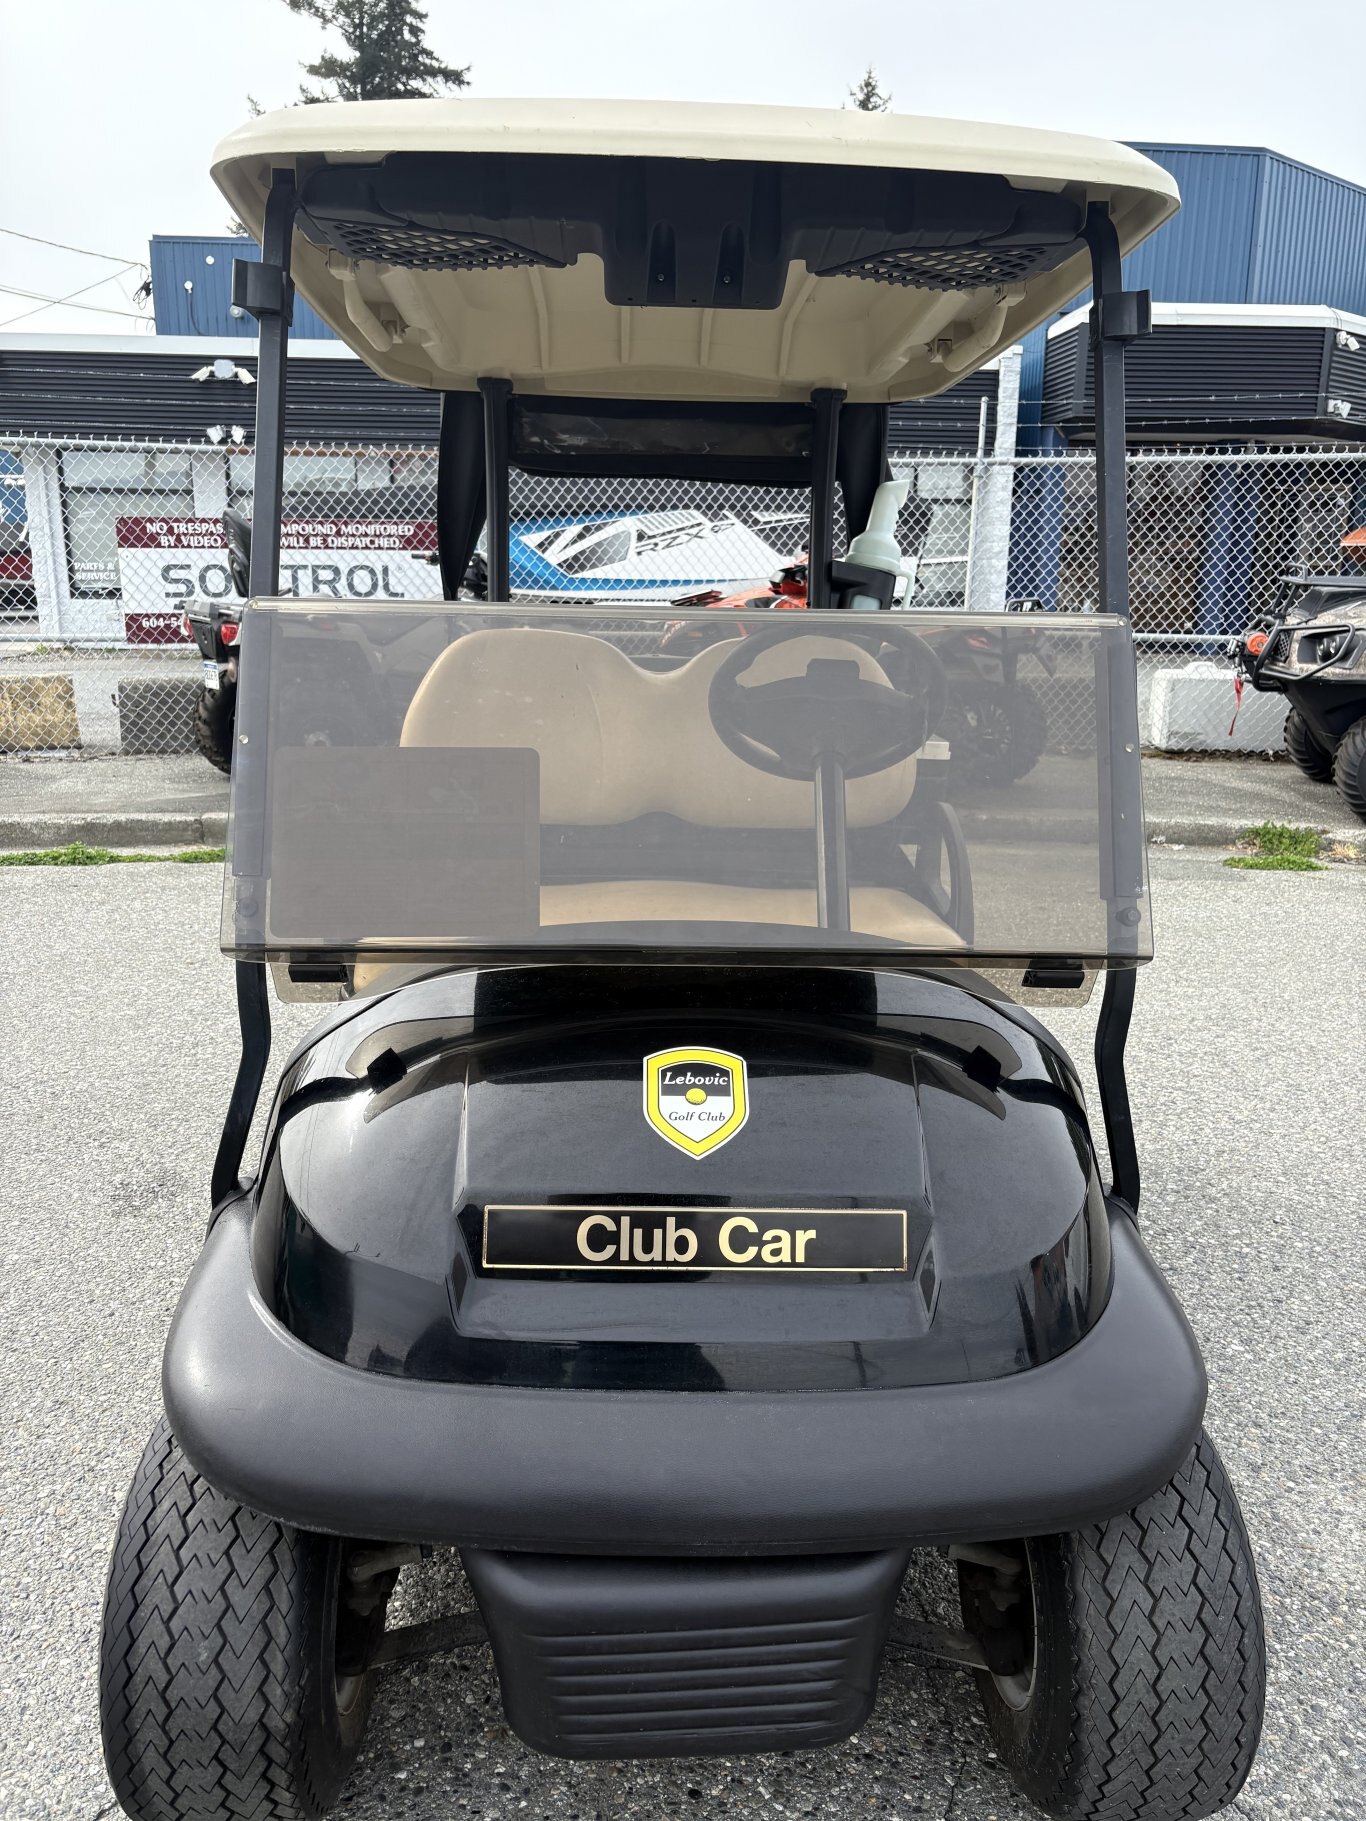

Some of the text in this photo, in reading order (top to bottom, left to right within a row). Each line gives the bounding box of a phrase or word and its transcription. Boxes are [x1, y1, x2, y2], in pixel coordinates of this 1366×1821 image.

[146, 522, 414, 536] NO TRESPAS MPOUND MONITORED
[160, 535, 403, 548] BY VIDEO WILL BE DISPATCHED.
[74, 562, 104, 571] PARTS
[75, 572, 117, 581] SERVICE
[160, 563, 405, 598] SOTROL
[141, 617, 184, 629] 604-54
[663, 1071, 729, 1086] Lebovic
[668, 1111, 726, 1122] Golf Club
[576, 1214, 816, 1264] Club Car
